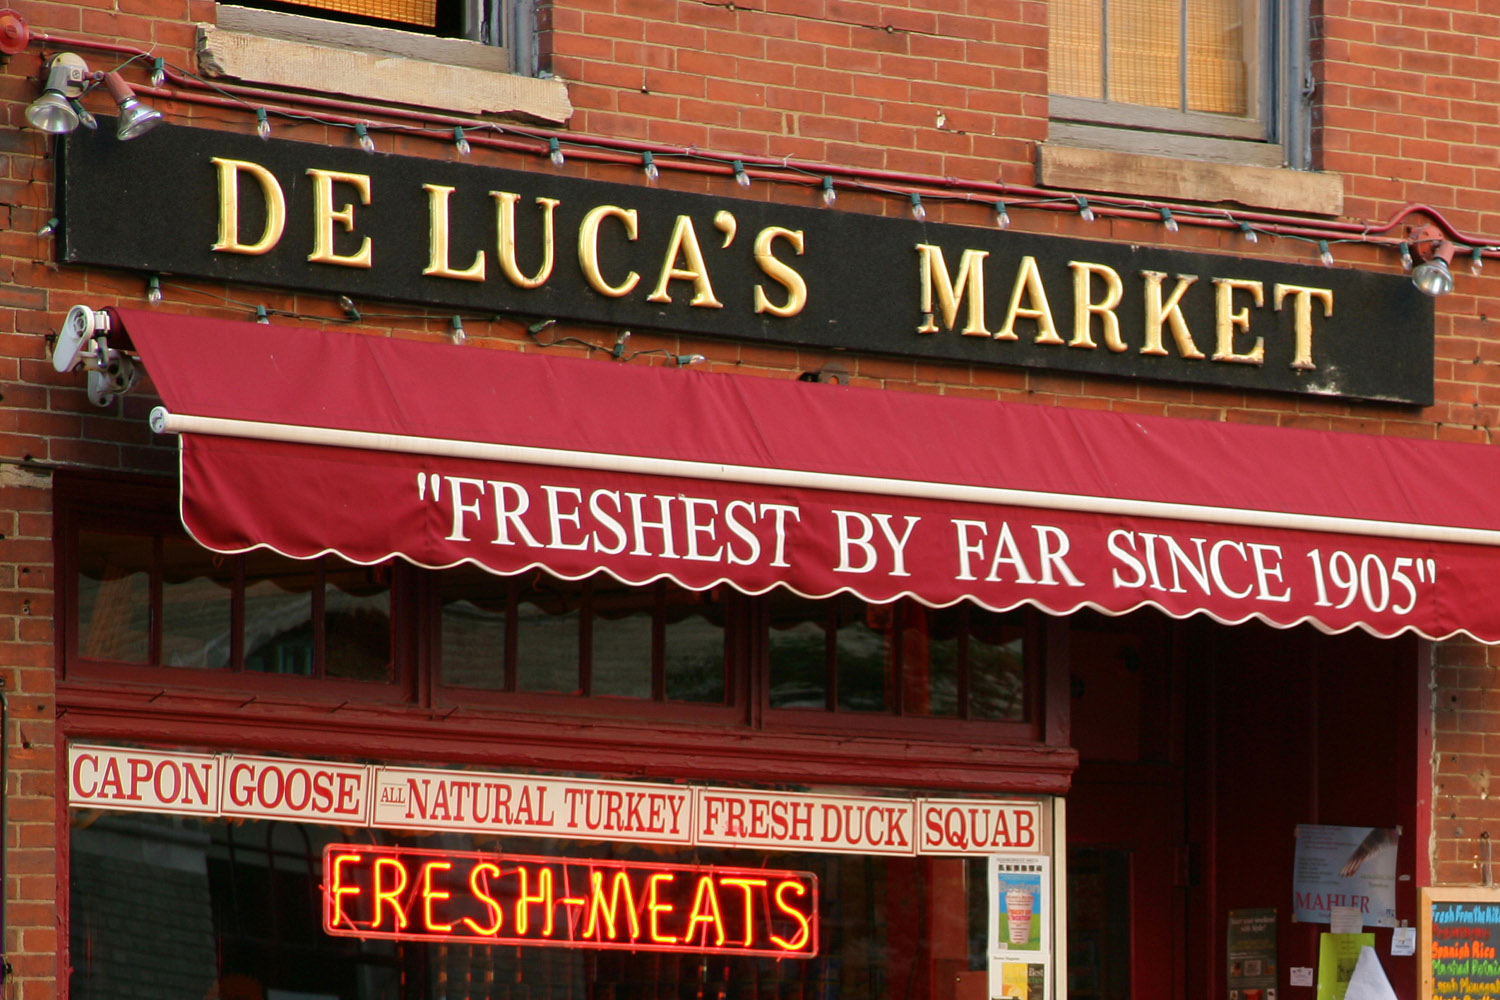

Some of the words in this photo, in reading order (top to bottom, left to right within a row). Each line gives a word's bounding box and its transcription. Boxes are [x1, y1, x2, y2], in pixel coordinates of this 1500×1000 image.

[210, 156, 373, 269] DE
[421, 184, 809, 318] LUCA'S
[915, 243, 1334, 370] MARKET
[416, 471, 802, 567] "FRESHEST
[832, 509, 921, 578] BY
[950, 518, 1085, 587] FAR
[1107, 528, 1292, 602] SINCE
[1308, 547, 1436, 615] 1905"
[72, 754, 213, 805] CAPON
[229, 763, 362, 815] GOOSE
[379, 787, 407, 805] ALL
[405, 778, 555, 826] NATURAL
[564, 788, 686, 835] TURKEY
[703, 796, 815, 841] FRESH
[820, 803, 909, 847] DUCK
[925, 807, 1036, 849] SQUAB
